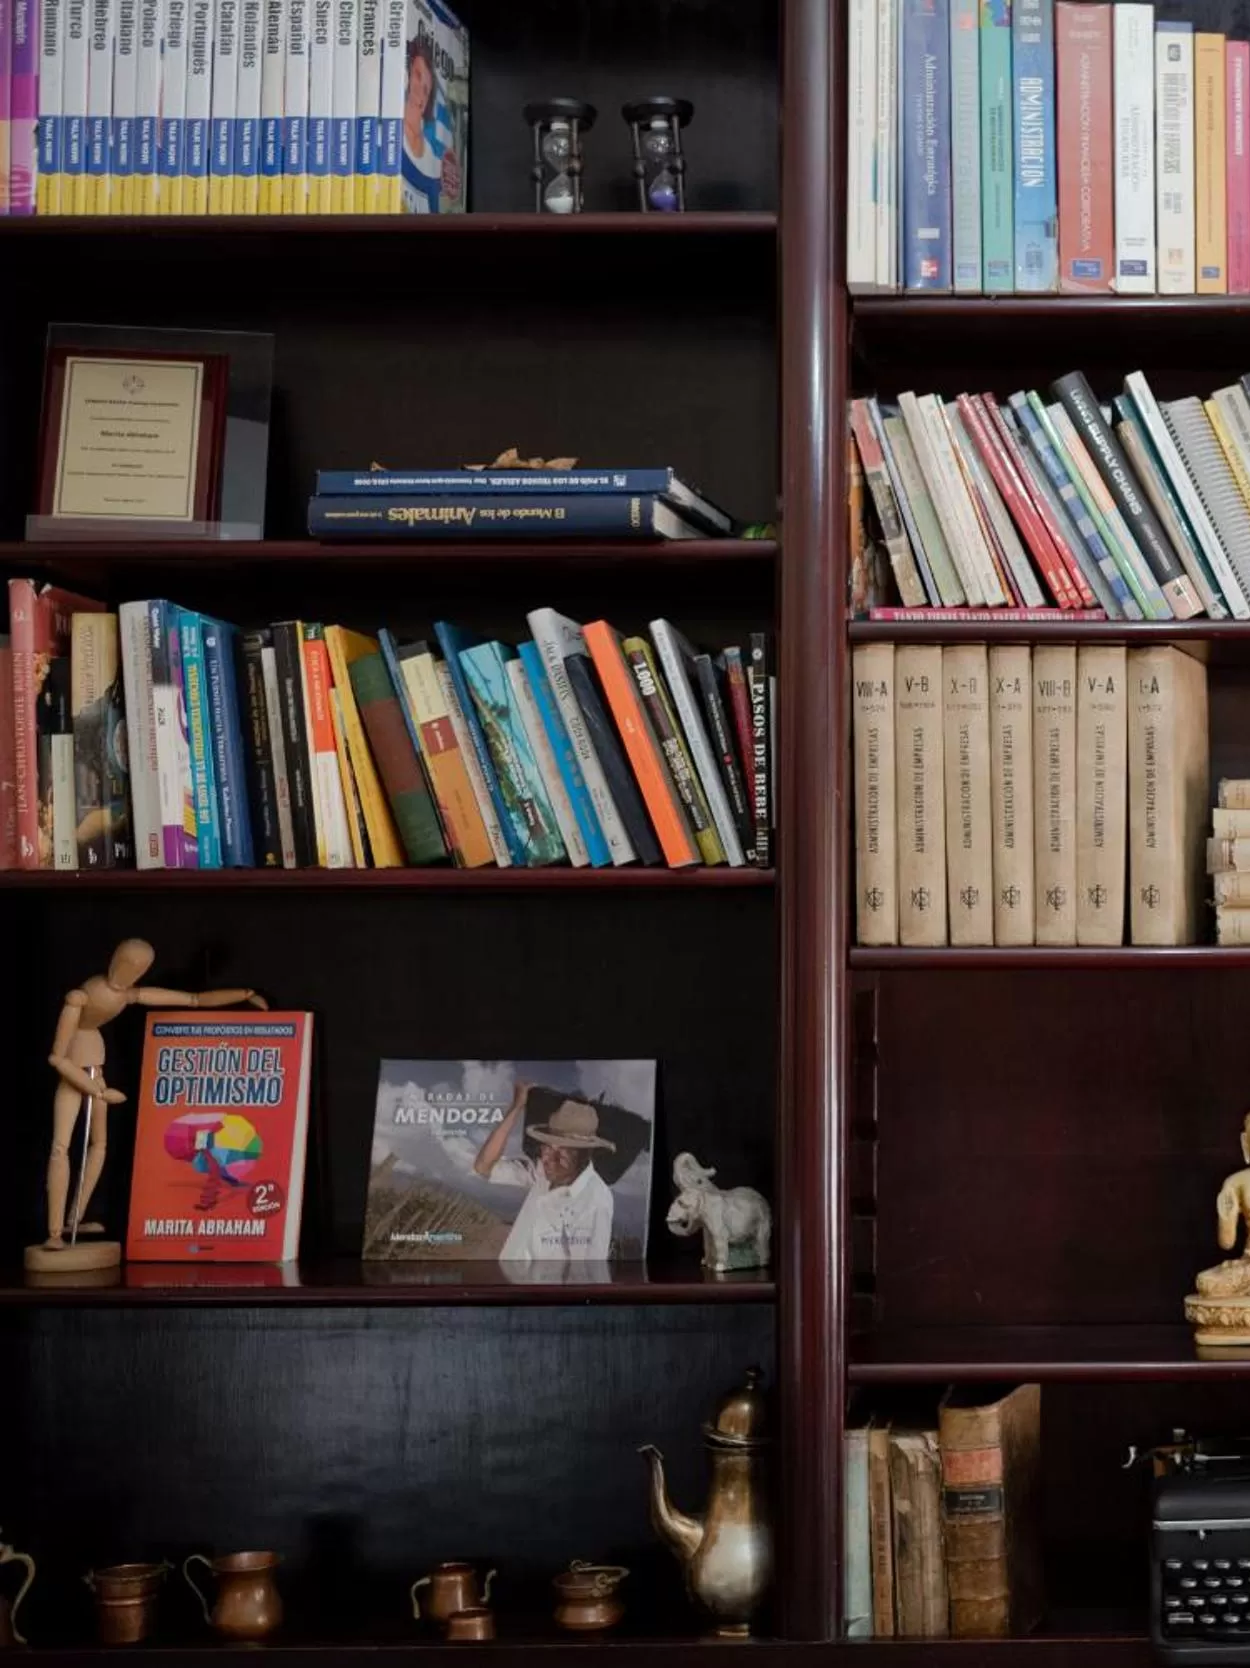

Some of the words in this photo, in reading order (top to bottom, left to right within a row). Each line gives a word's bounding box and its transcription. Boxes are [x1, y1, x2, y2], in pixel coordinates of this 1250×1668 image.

[167, 1, 184, 49] Griego
[266, 0, 283, 54] Alemán
[316, 1, 330, 45] Sueco
[338, 1, 353, 46] Checo
[388, 1, 404, 48] Griego
[924, 53, 938, 138] Administración
[1086, 422, 1118, 471] SUPPLY
[1112, 468, 1142, 516] CHAINS
[388, 506, 476, 526] Animales
[480, 508, 495, 519] los
[497, 508, 511, 519] de
[513, 508, 552, 520] Mundo
[554, 508, 566, 519] El
[12, 652, 24, 691] RUFIN
[632, 662, 658, 696] 1.000
[904, 676, 930, 692] V-B
[995, 677, 1022, 694] X-A
[1088, 676, 1114, 694] V-A
[752, 684, 766, 738] PASOS
[14, 695, 29, 812] JEAN-CHRISTOPHE
[753, 744, 766, 768] DE
[868, 766, 880, 782] DE
[912, 766, 924, 782] DE
[960, 764, 972, 778] DE
[1003, 766, 1014, 778] DE
[1050, 766, 1061, 782] DE
[1096, 764, 1106, 776] DE
[1146, 762, 1158, 776] DE
[158, 1042, 242, 1074] GESTIÓN
[246, 1047, 286, 1075] DEL
[154, 1075, 283, 1106] OPTIMISMO
[395, 1108, 504, 1124] MENDOZA
[144, 1219, 194, 1236] MARITA
[197, 1219, 266, 1237] ABRAHAM
